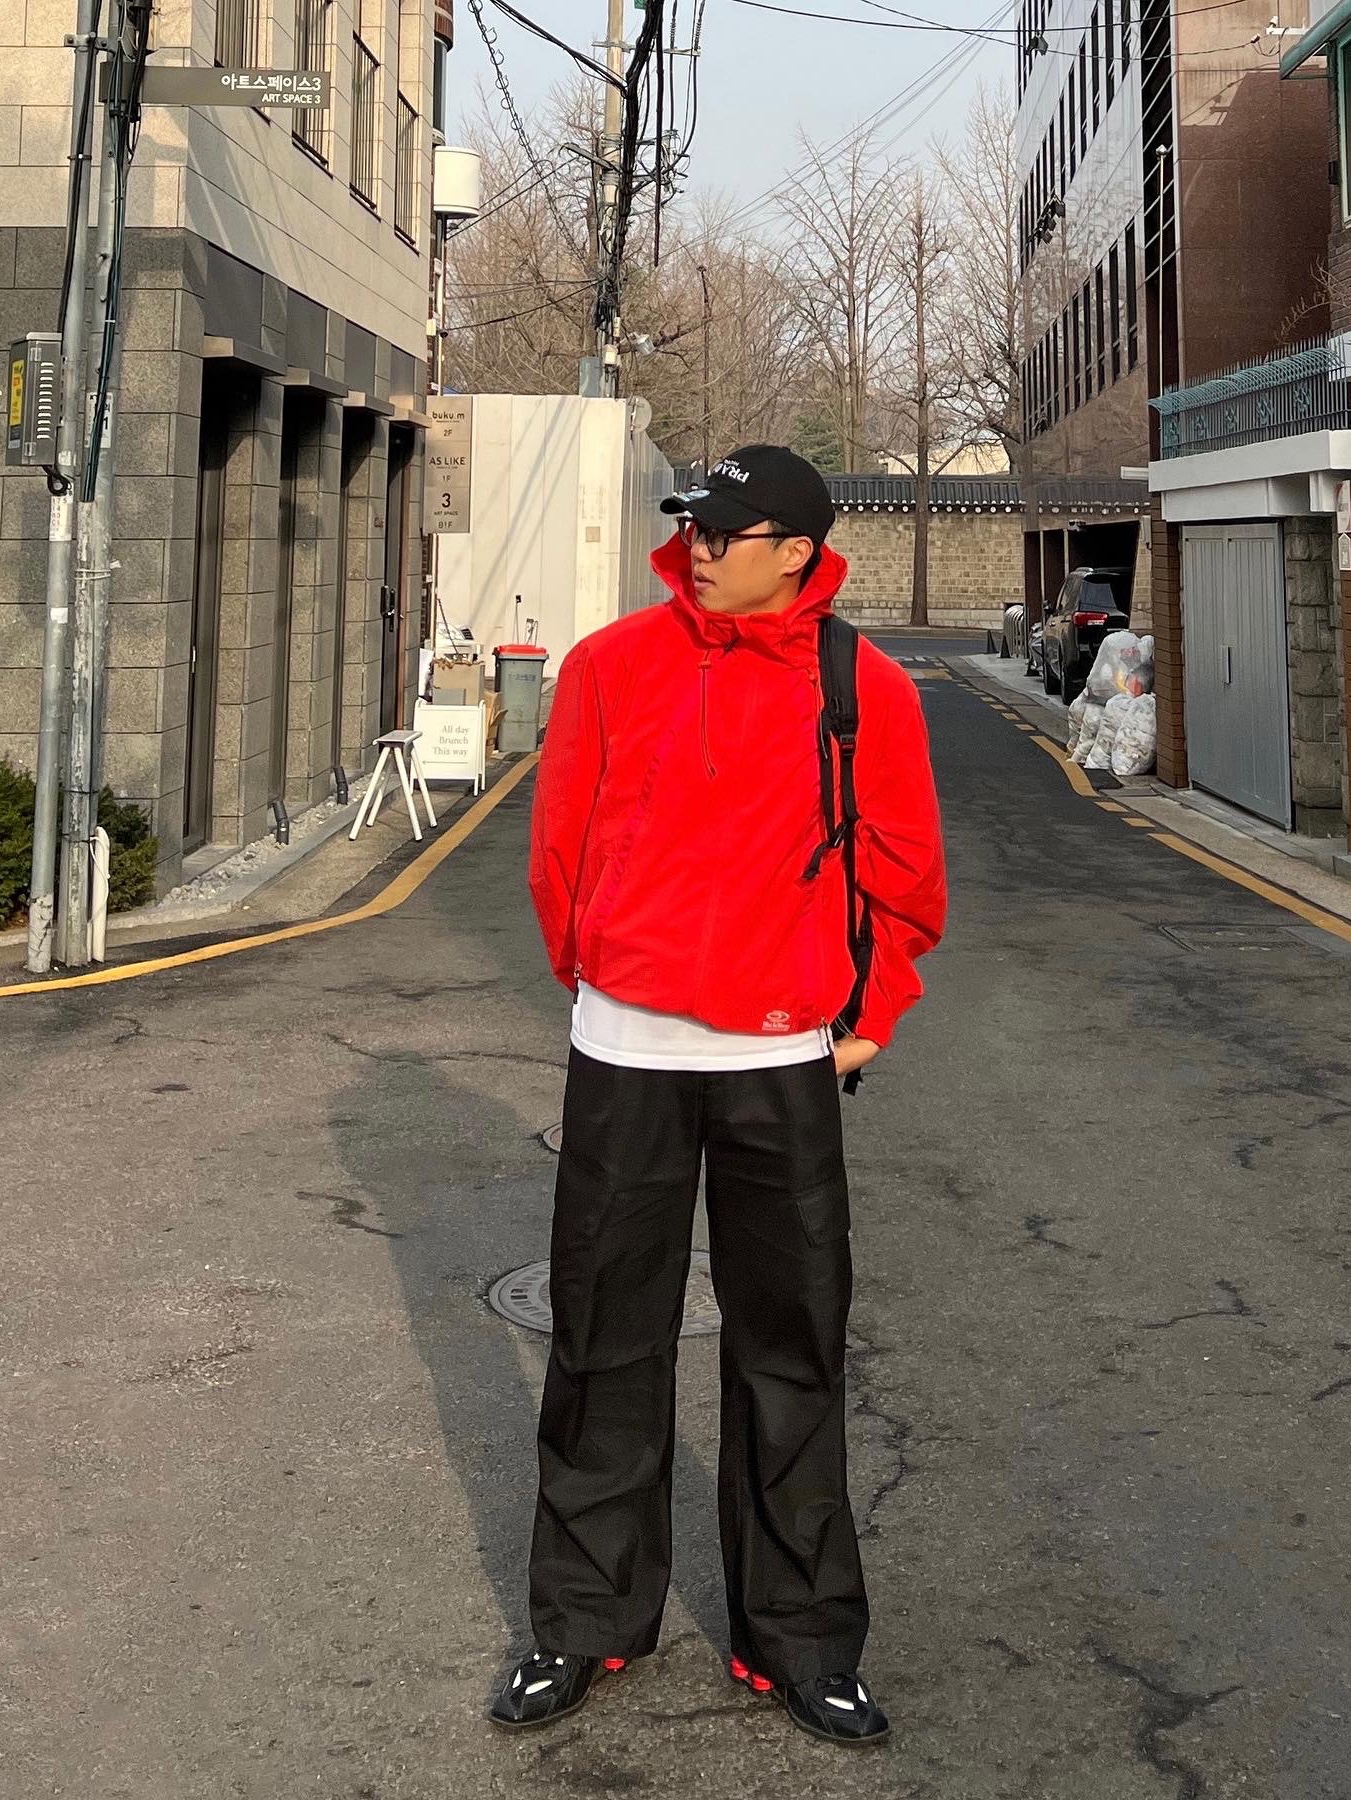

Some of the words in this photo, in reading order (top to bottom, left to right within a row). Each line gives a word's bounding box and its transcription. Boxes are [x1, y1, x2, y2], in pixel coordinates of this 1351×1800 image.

[221, 73, 321, 92] 아트스페이스3
[262, 93, 281, 103] ART
[282, 94, 313, 104] SPACE
[314, 95, 321, 104] 3
[429, 456, 442, 466] AS
[444, 456, 467, 466] LIKE
[441, 492, 451, 508] 3
[442, 725, 453, 734] All
[455, 725, 469, 736] day
[439, 736, 469, 745] Brunch
[433, 746, 450, 755] This
[452, 748, 469, 758] way
